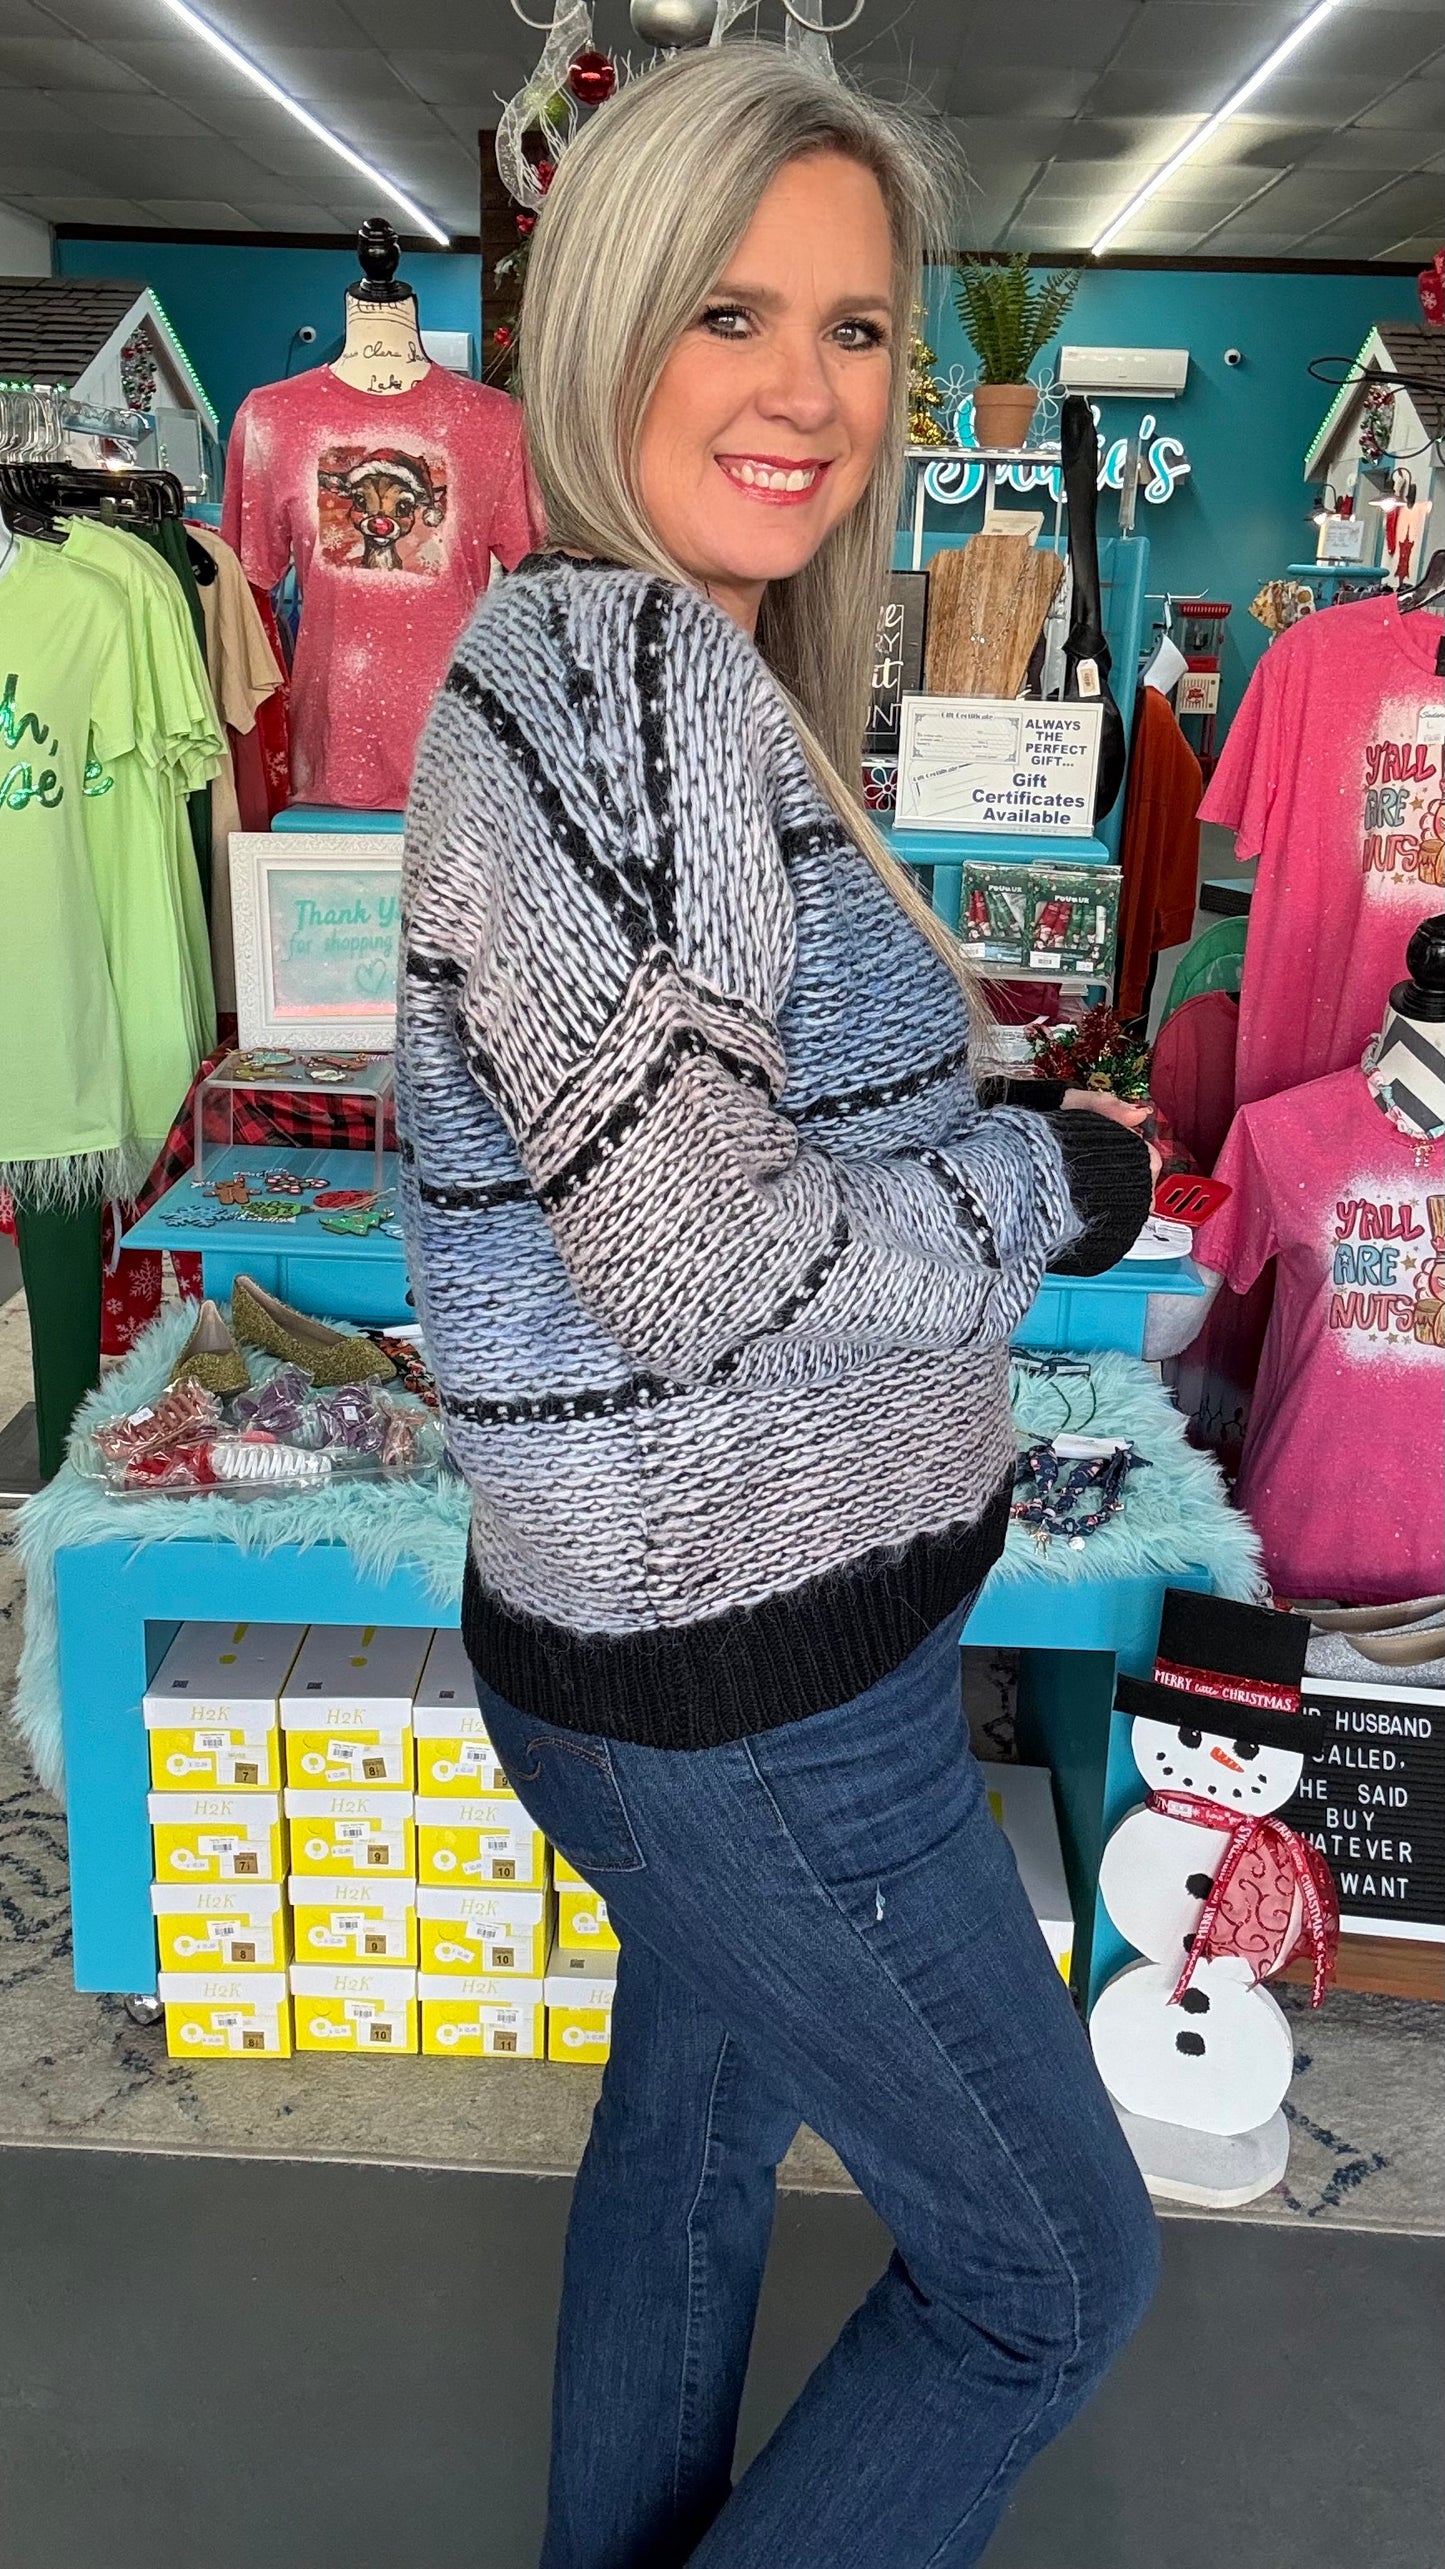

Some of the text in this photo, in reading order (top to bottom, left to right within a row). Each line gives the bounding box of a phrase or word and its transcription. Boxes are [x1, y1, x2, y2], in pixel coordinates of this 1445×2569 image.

[1025, 719, 1081, 731] ALWAYS
[1036, 731, 1063, 742] THE
[1025, 743, 1087, 755] PERFECT
[1031, 755, 1074, 767] GIFT...
[1012, 773, 1047, 789] Gift
[972, 789, 1085, 808] Certificates
[983, 807, 1071, 825] Available
[1364, 787, 1410, 831] ARE
[1362, 834, 1420, 873] NUTS
[295, 899, 372, 931] Thank
[1333, 1243, 1400, 1287] ARE
[1329, 1291, 1415, 1332] NUTS
[1154, 1669, 1193, 1691] MERRY
[1221, 1687, 1292, 1712] CHRISTMAS
[190, 1705, 231, 1721] H2K
[326, 1708, 366, 1725] H2K
[460, 1717, 484, 1734] H2
[1335, 1710, 1432, 1738] HUSBAND
[1357, 1784, 1408, 1807] SAID
[194, 1800, 234, 1816] H2K
[330, 1797, 370, 1814] H2K
[459, 1804, 499, 1822] H2K
[1326, 1807, 1375, 1831] BUY
[1301, 1831, 1413, 1863] ATEVER
[498, 1867, 511, 1878] 10
[334, 1884, 374, 1901] H2K
[1340, 1872, 1409, 1899] WANT
[197, 1893, 237, 1909] H2K
[460, 1898, 500, 1916] H2K
[496, 1954, 509, 1965] 10
[202, 1981, 242, 1998] H2K
[333, 1975, 374, 1991] H2K
[461, 1983, 501, 1995] H2K
[374, 2030, 388, 2041] 10
